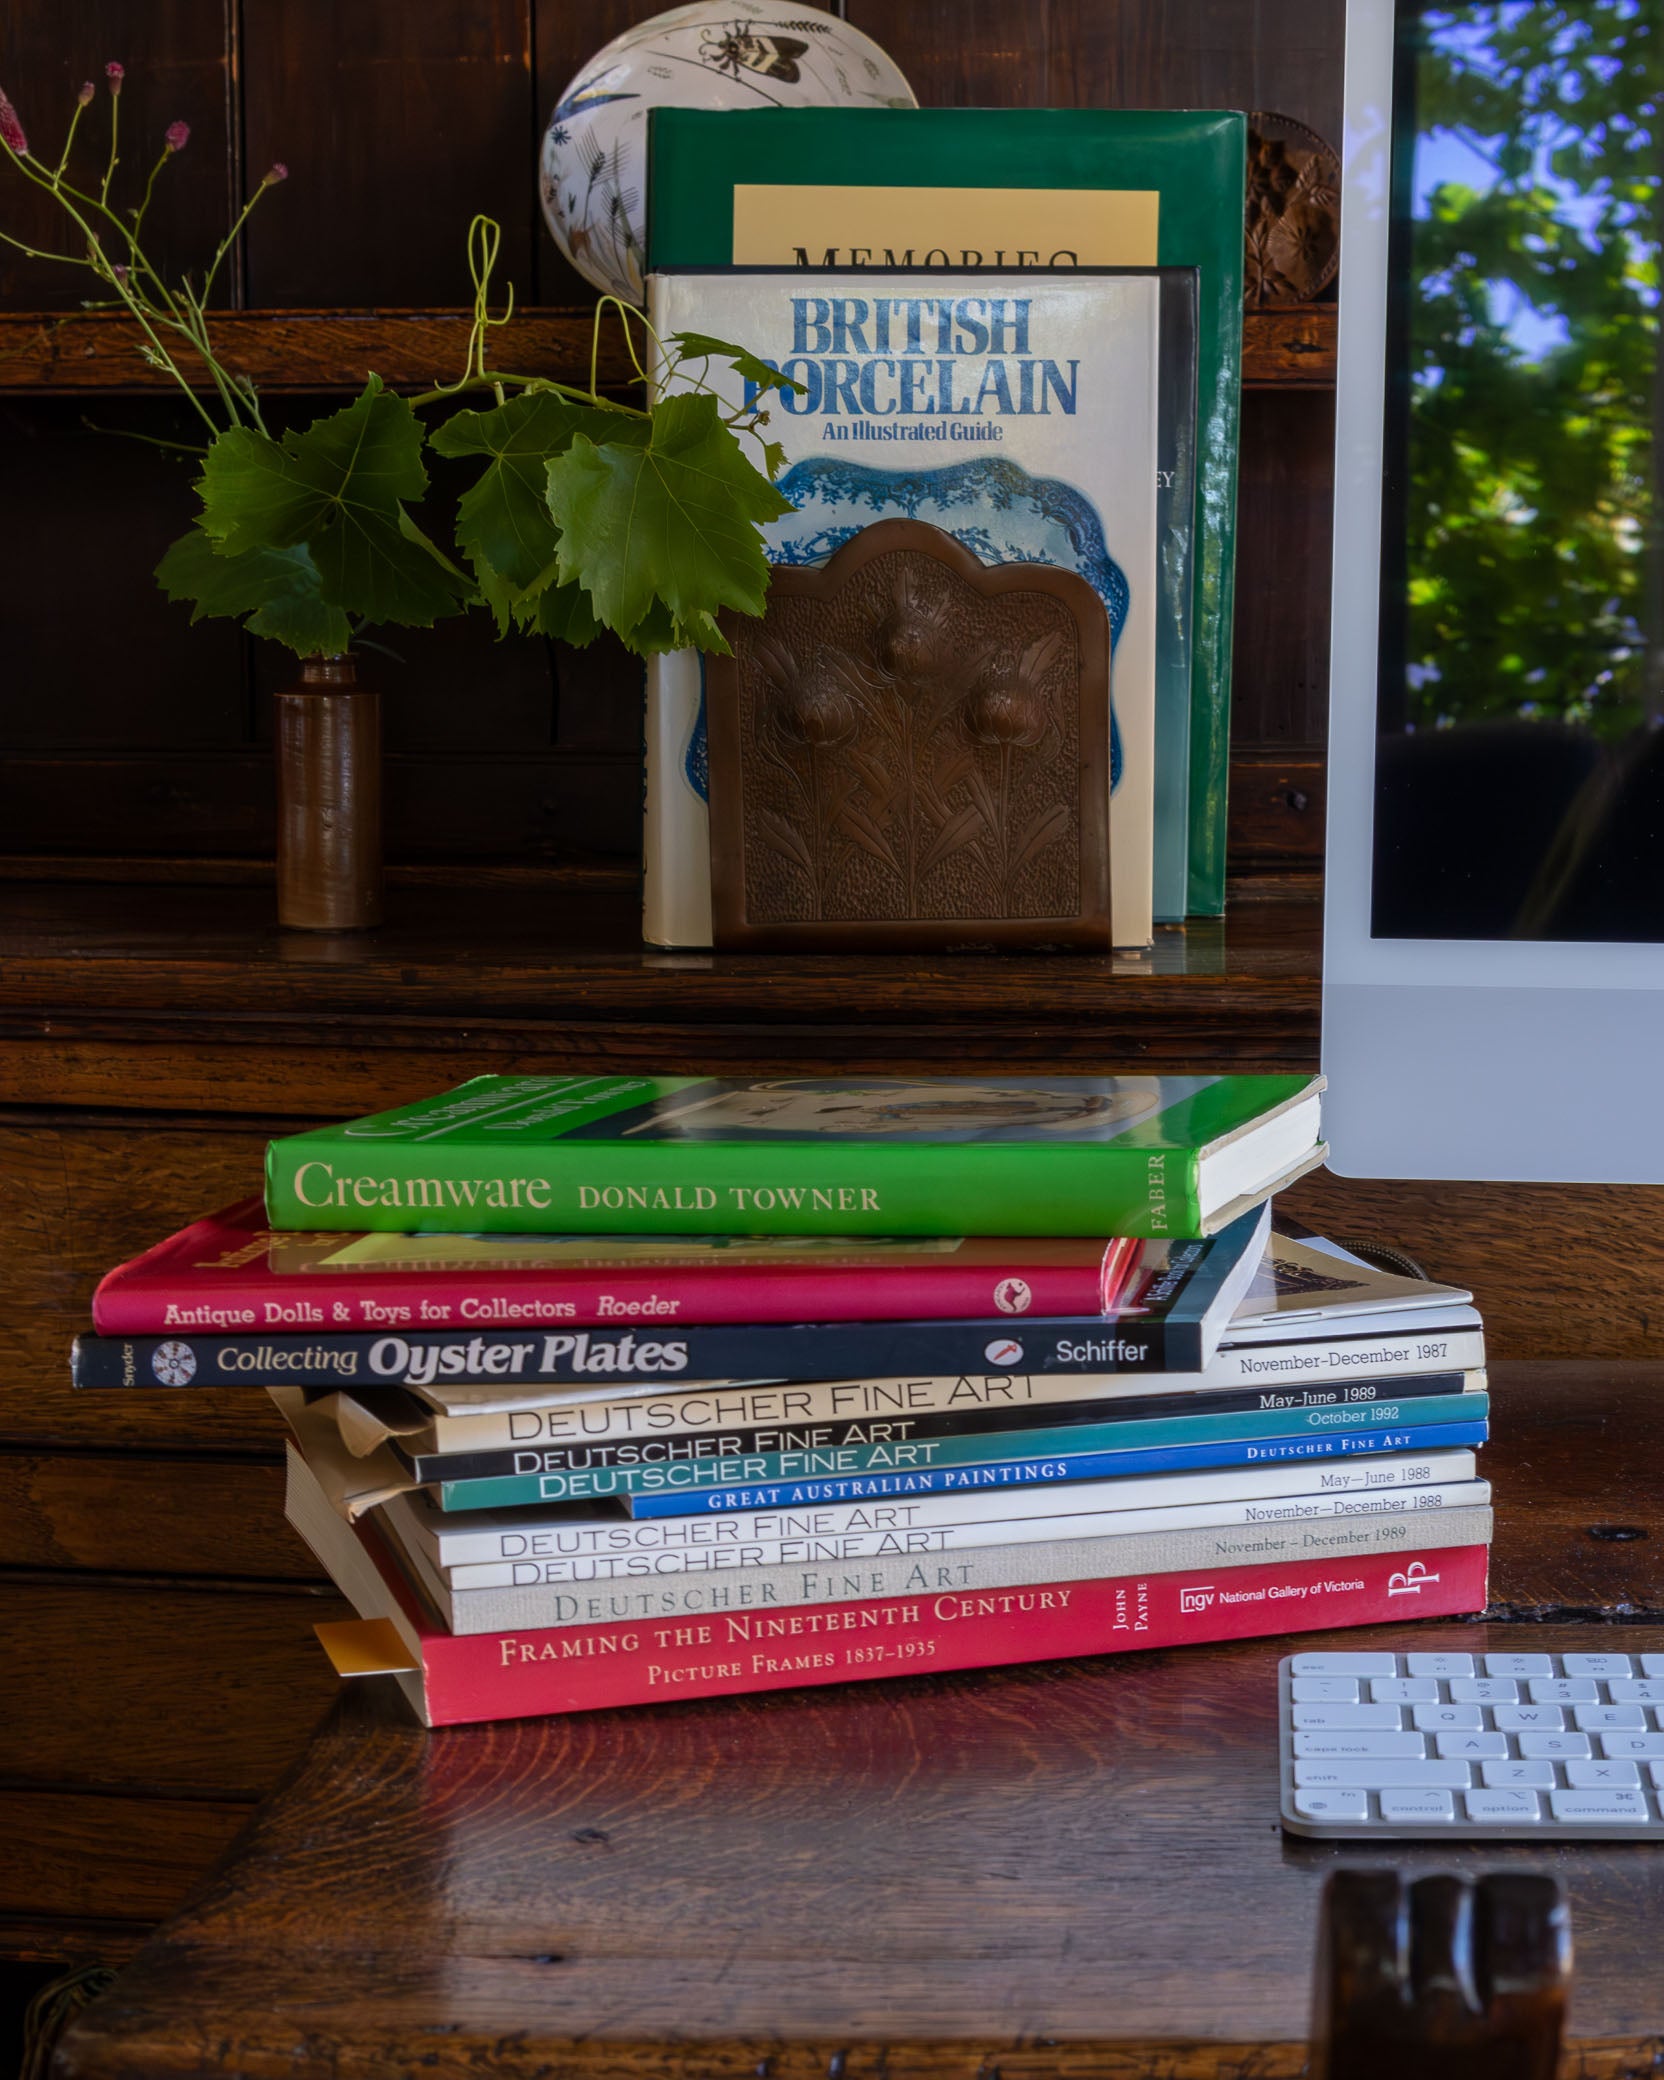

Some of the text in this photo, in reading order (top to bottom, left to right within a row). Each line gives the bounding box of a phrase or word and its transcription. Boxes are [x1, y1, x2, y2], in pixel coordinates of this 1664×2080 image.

[789, 297, 1033, 355] BRITISH
[822, 420, 1003, 441] An Illustrated Guide
[294, 1161, 881, 1211] Creamware DONALD TOWNER
[1148, 1153, 1168, 1231] FABER
[163, 1295, 680, 1328] Antique Dolls & Toys for Collectors Roeder
[120, 1342, 135, 1387] Snyder
[217, 1333, 688, 1385] Collecting Oyster Plates
[1056, 1339, 1149, 1362] Schiffer
[1417, 1342, 1448, 1359] 1987
[508, 1375, 1032, 1441] DEUTSCHER FINE ART
[1343, 1386, 1376, 1402] 1989
[1309, 1407, 1399, 1426] October 1992
[513, 1421, 915, 1475] DEUTSCHER FINE ART
[1247, 1434, 1412, 1459] DEUTSCHER FINE ART
[539, 1443, 940, 1498] DEUTSCHER FINE ART
[708, 1462, 1068, 1509] GREAT AUSTRALIAN PAINTINGS
[1401, 1466, 1431, 1481] 1988
[1412, 1494, 1442, 1509] 1988
[500, 1505, 921, 1557] DEUTSCHER FINE ART
[1215, 1534, 1285, 1555] November
[1303, 1530, 1369, 1548] December
[1375, 1526, 1407, 1541] 1989
[512, 1530, 955, 1586] DEUTSCHER FINE ART
[555, 1563, 974, 1622] DEUTSCHER FINE ART
[1134, 1582, 1149, 1631] PAYNE
[1184, 1579, 1365, 1612] ngv National Gallery of Victoria
[1112, 1589, 1129, 1630] JOHN
[498, 1590, 1072, 1666] FRAMING THE NINETEENTH CENTURY
[648, 1662, 742, 1685] PICTURE
[752, 1652, 835, 1675] FRAMES
[1441, 1712, 1455, 1721] Q
[1519, 1713, 1538, 1721] W
[1465, 1740, 1480, 1748] A
[1548, 1740, 1563, 1748] S
[1511, 1769, 1526, 1777] Z
[1595, 1769, 1610, 1777] X
[1482, 1805, 1529, 1813] option
